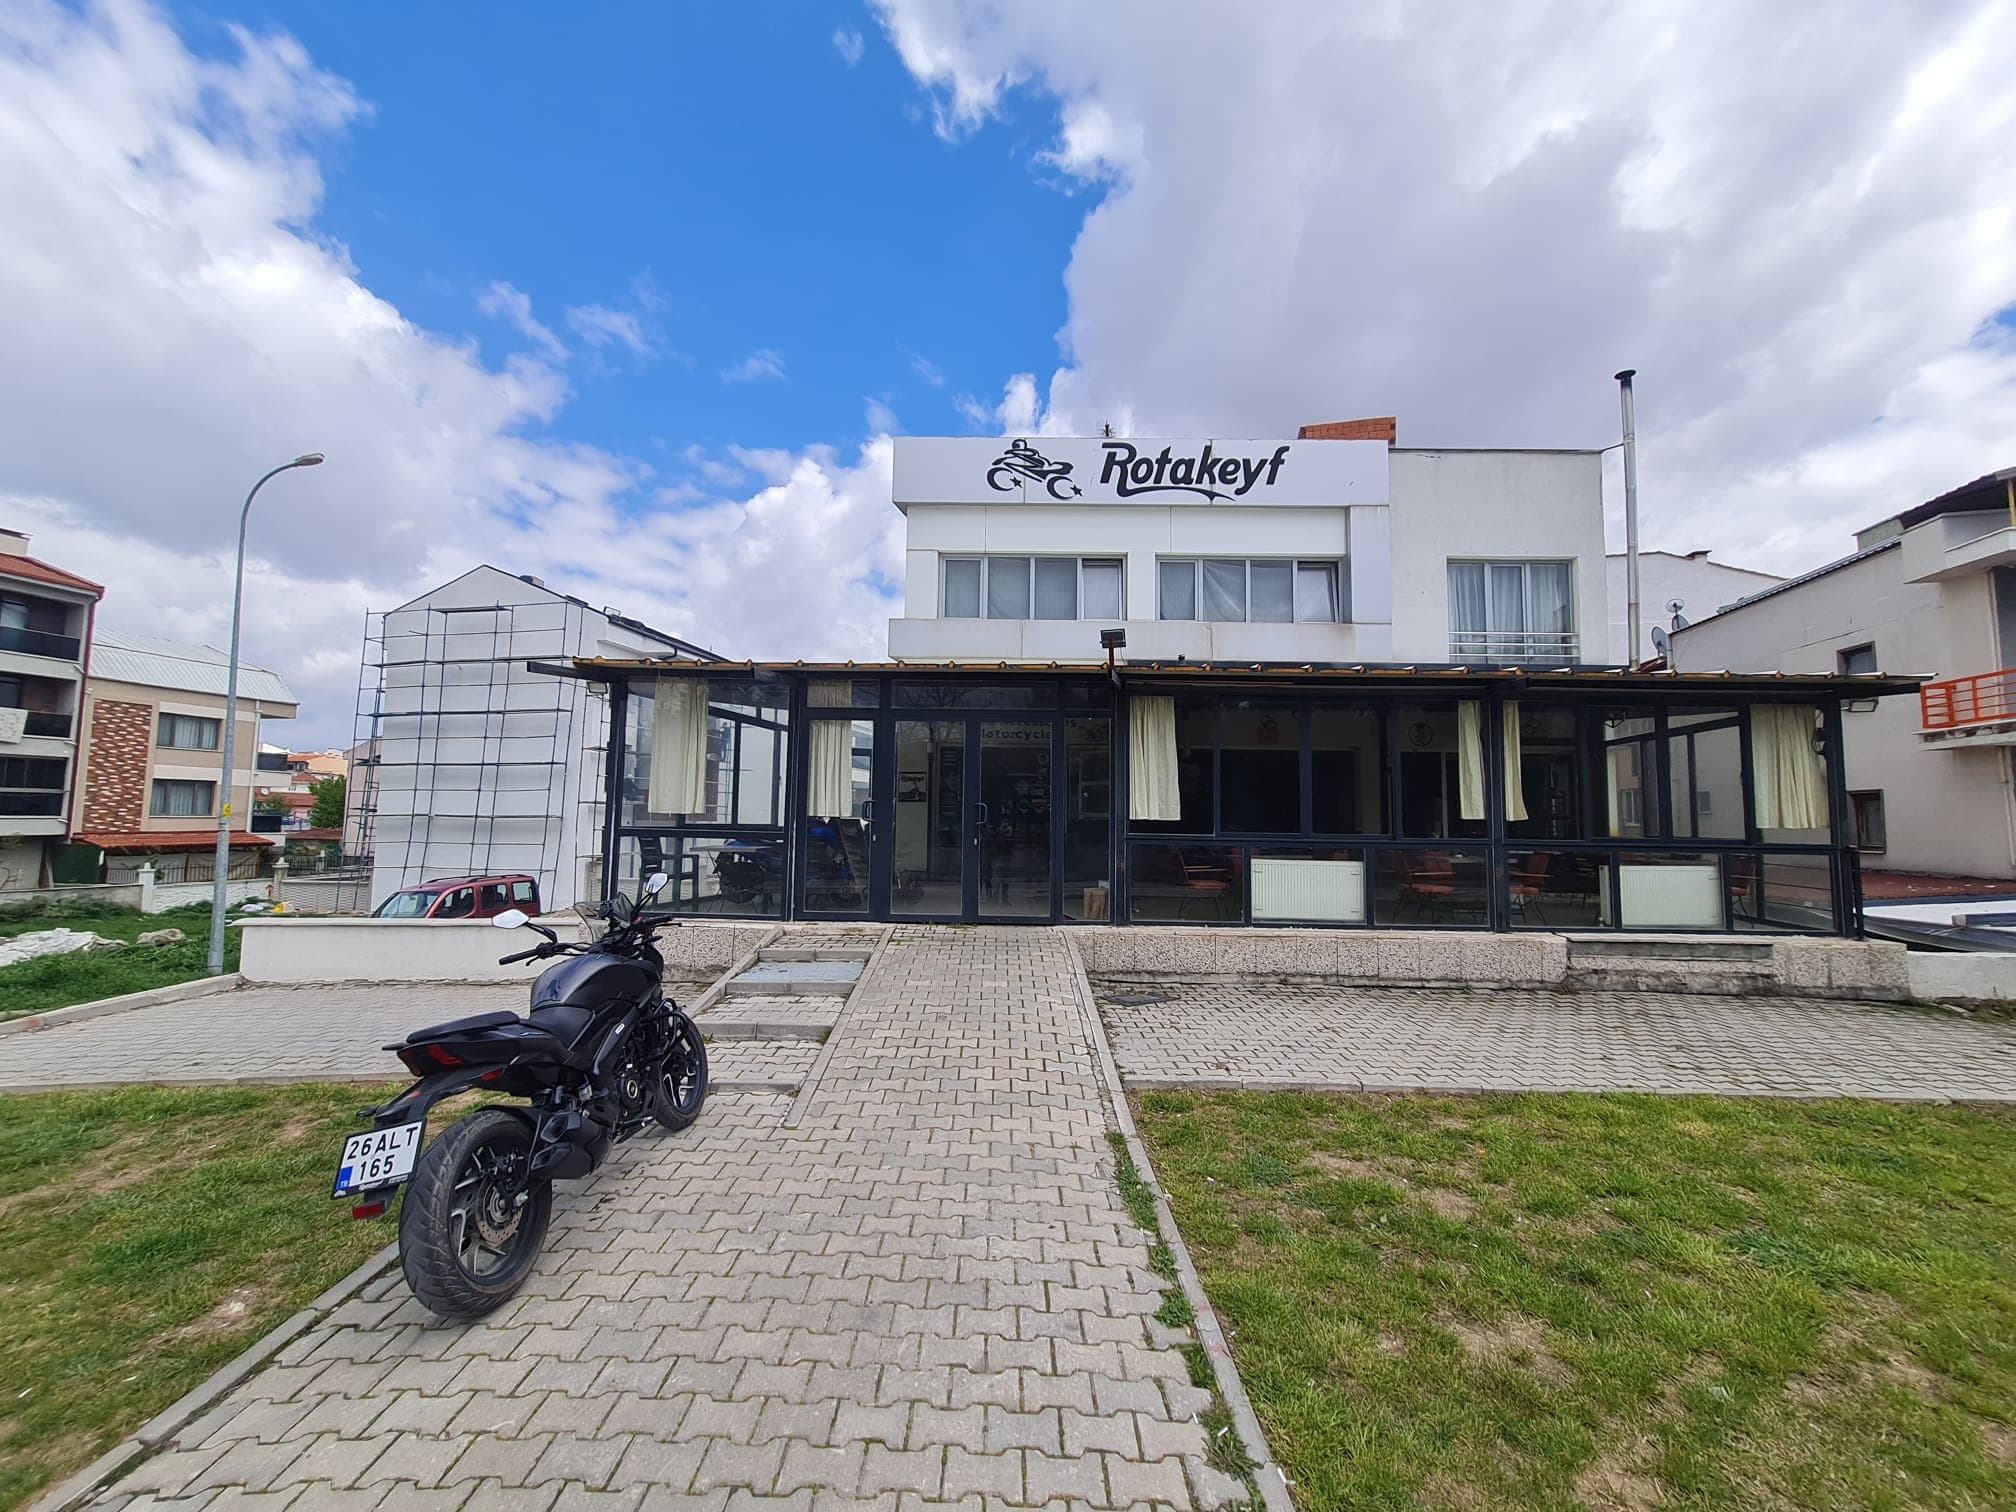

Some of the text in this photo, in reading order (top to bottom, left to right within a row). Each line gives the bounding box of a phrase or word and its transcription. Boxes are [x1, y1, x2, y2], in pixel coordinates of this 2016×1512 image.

[1100, 442, 1290, 502] Rotakeyf
[982, 728, 1052, 741] otorcycle
[360, 1154, 395, 1180] 165
